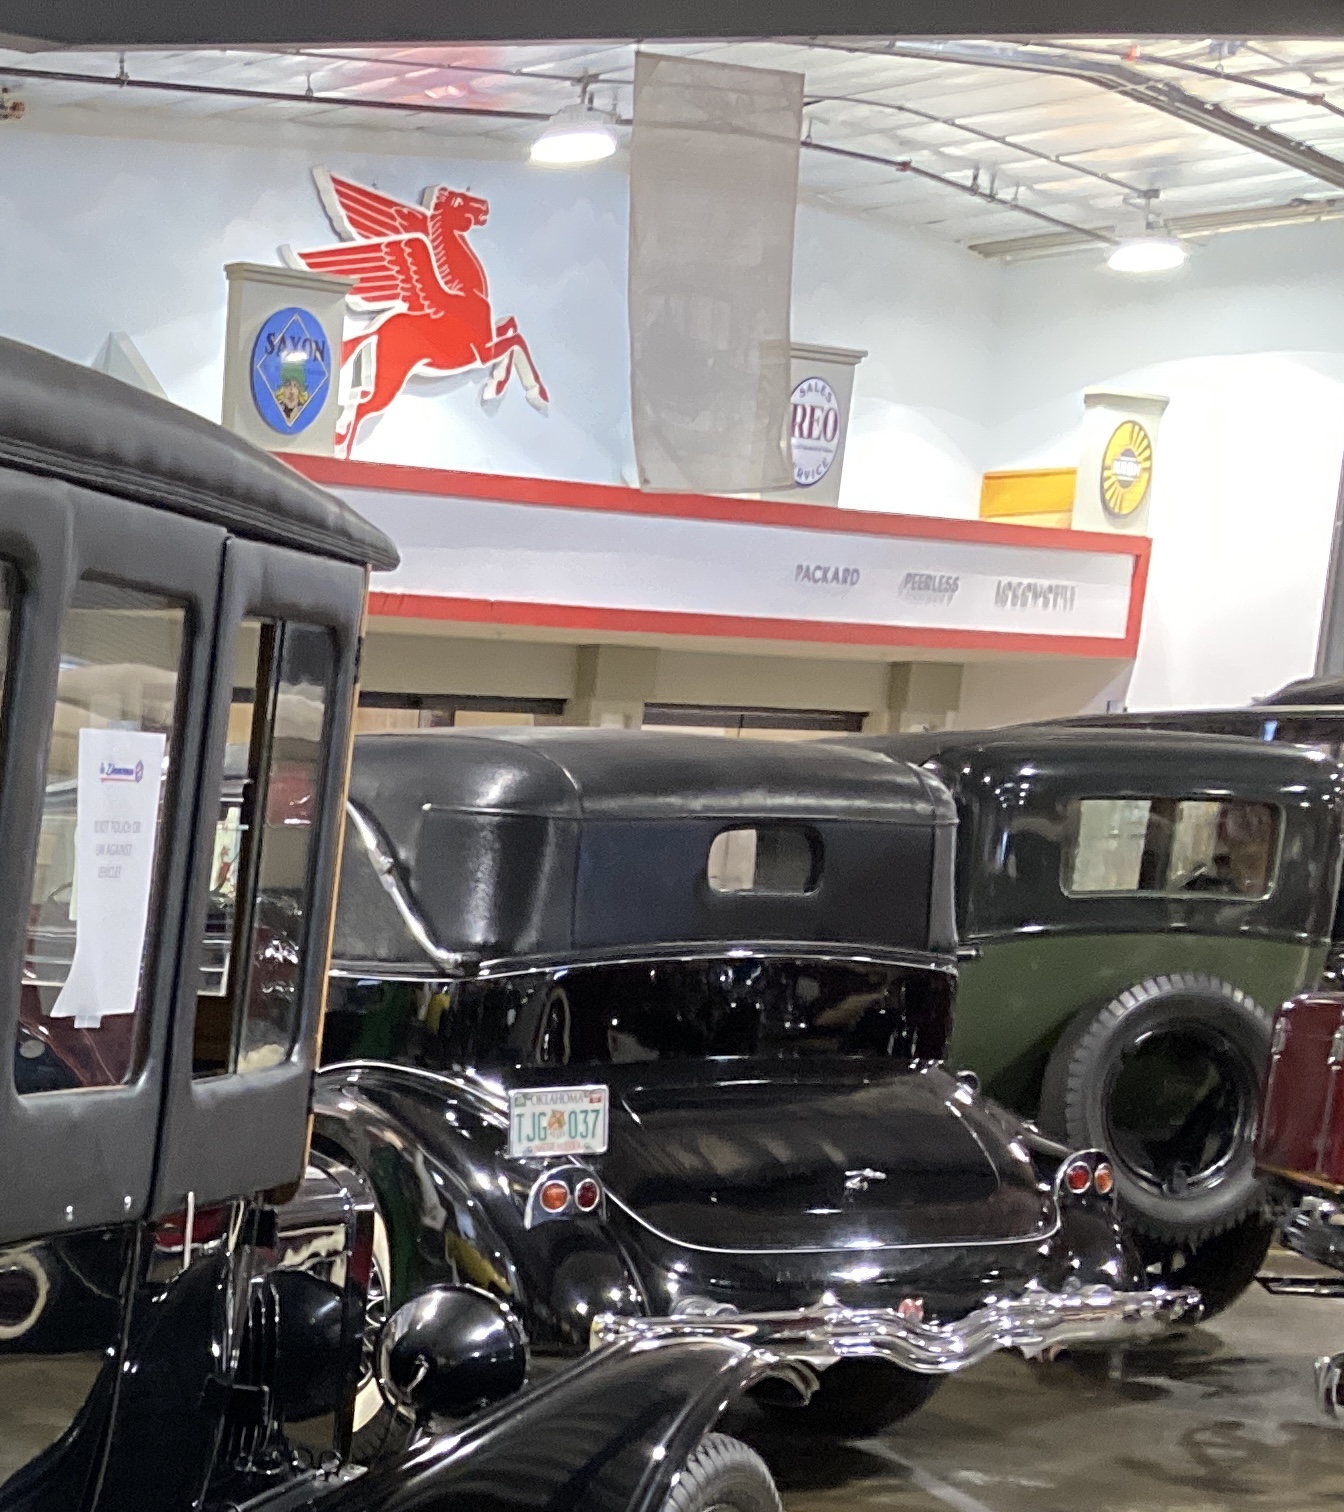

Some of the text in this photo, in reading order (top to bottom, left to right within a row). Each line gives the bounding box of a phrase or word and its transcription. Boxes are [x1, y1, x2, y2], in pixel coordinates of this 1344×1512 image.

[799, 381, 833, 403] SALES
[790, 402, 838, 442] REO
[794, 564, 860, 587] PACKARD
[902, 571, 960, 594] PEERLESS
[530, 1092, 585, 1106] OKLAHOMA
[516, 1109, 601, 1143] TJG 037
